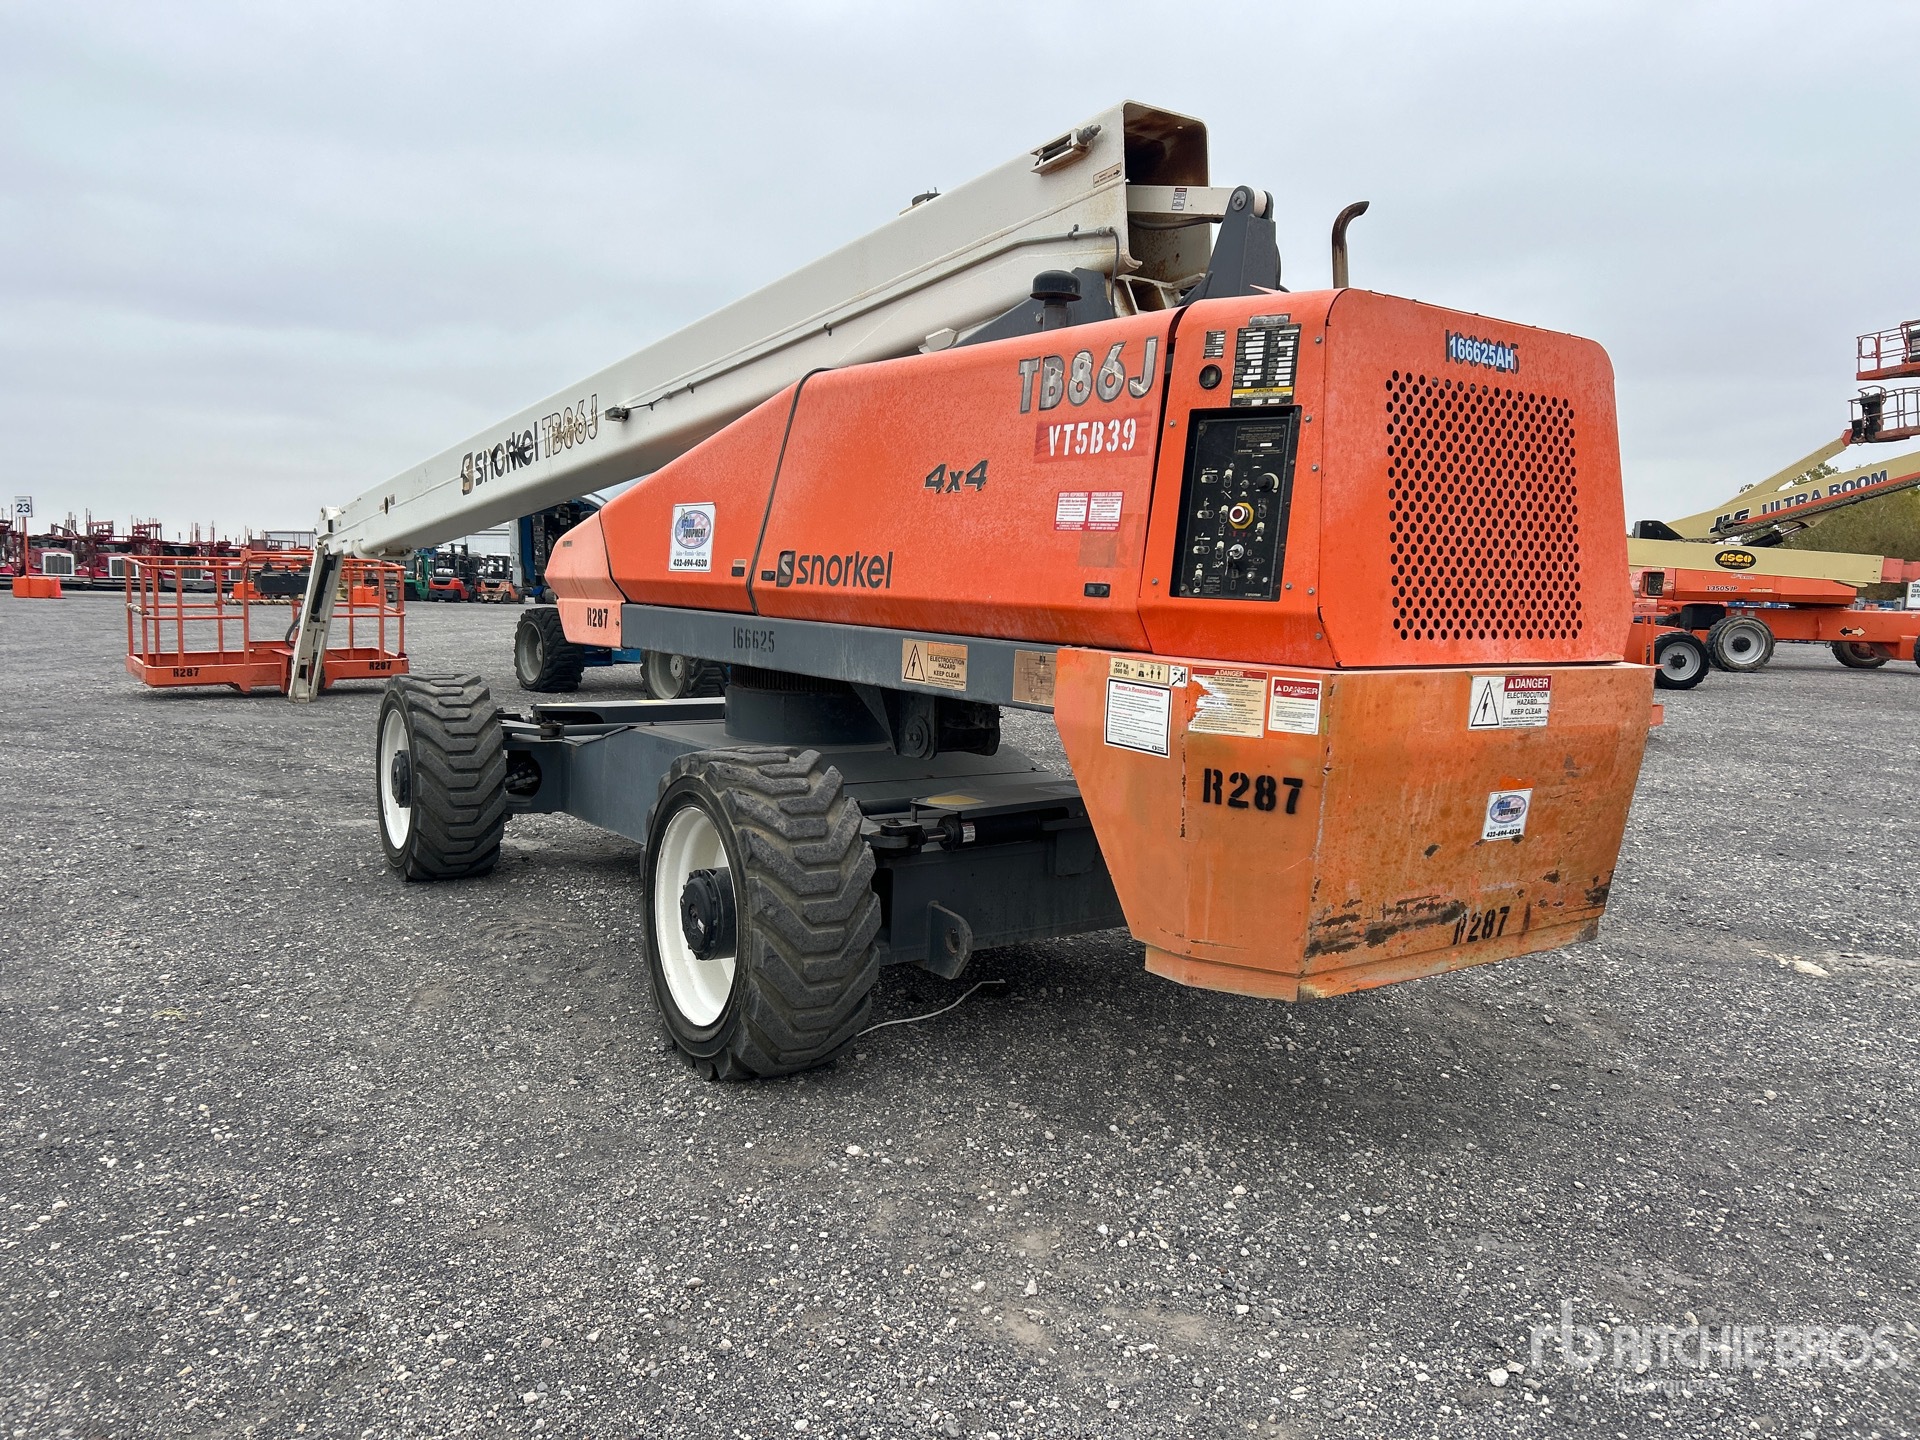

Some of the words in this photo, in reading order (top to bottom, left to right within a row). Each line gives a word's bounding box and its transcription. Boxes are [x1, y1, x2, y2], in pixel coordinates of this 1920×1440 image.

[1449, 335, 1514, 370] 166625AH
[1018, 336, 1158, 413] TB86J
[1048, 418, 1137, 457] VT5B39
[924, 459, 990, 494] 4x4
[1828, 470, 1888, 497] BOOM
[16, 503, 30, 513] 23
[796, 550, 894, 589] snorkel
[1720, 553, 1752, 563] ASCO
[733, 626, 775, 653] 166625
[1220, 669, 1244, 678] DANGER
[1515, 677, 1549, 689] DANGER
[1282, 685, 1318, 695] DANGER
[1506, 691, 1549, 699] ELECTROCUTION
[1510, 708, 1524, 716] KEEP
[1525, 707, 1542, 715] CLEAR
[1203, 767, 1304, 815] R287
